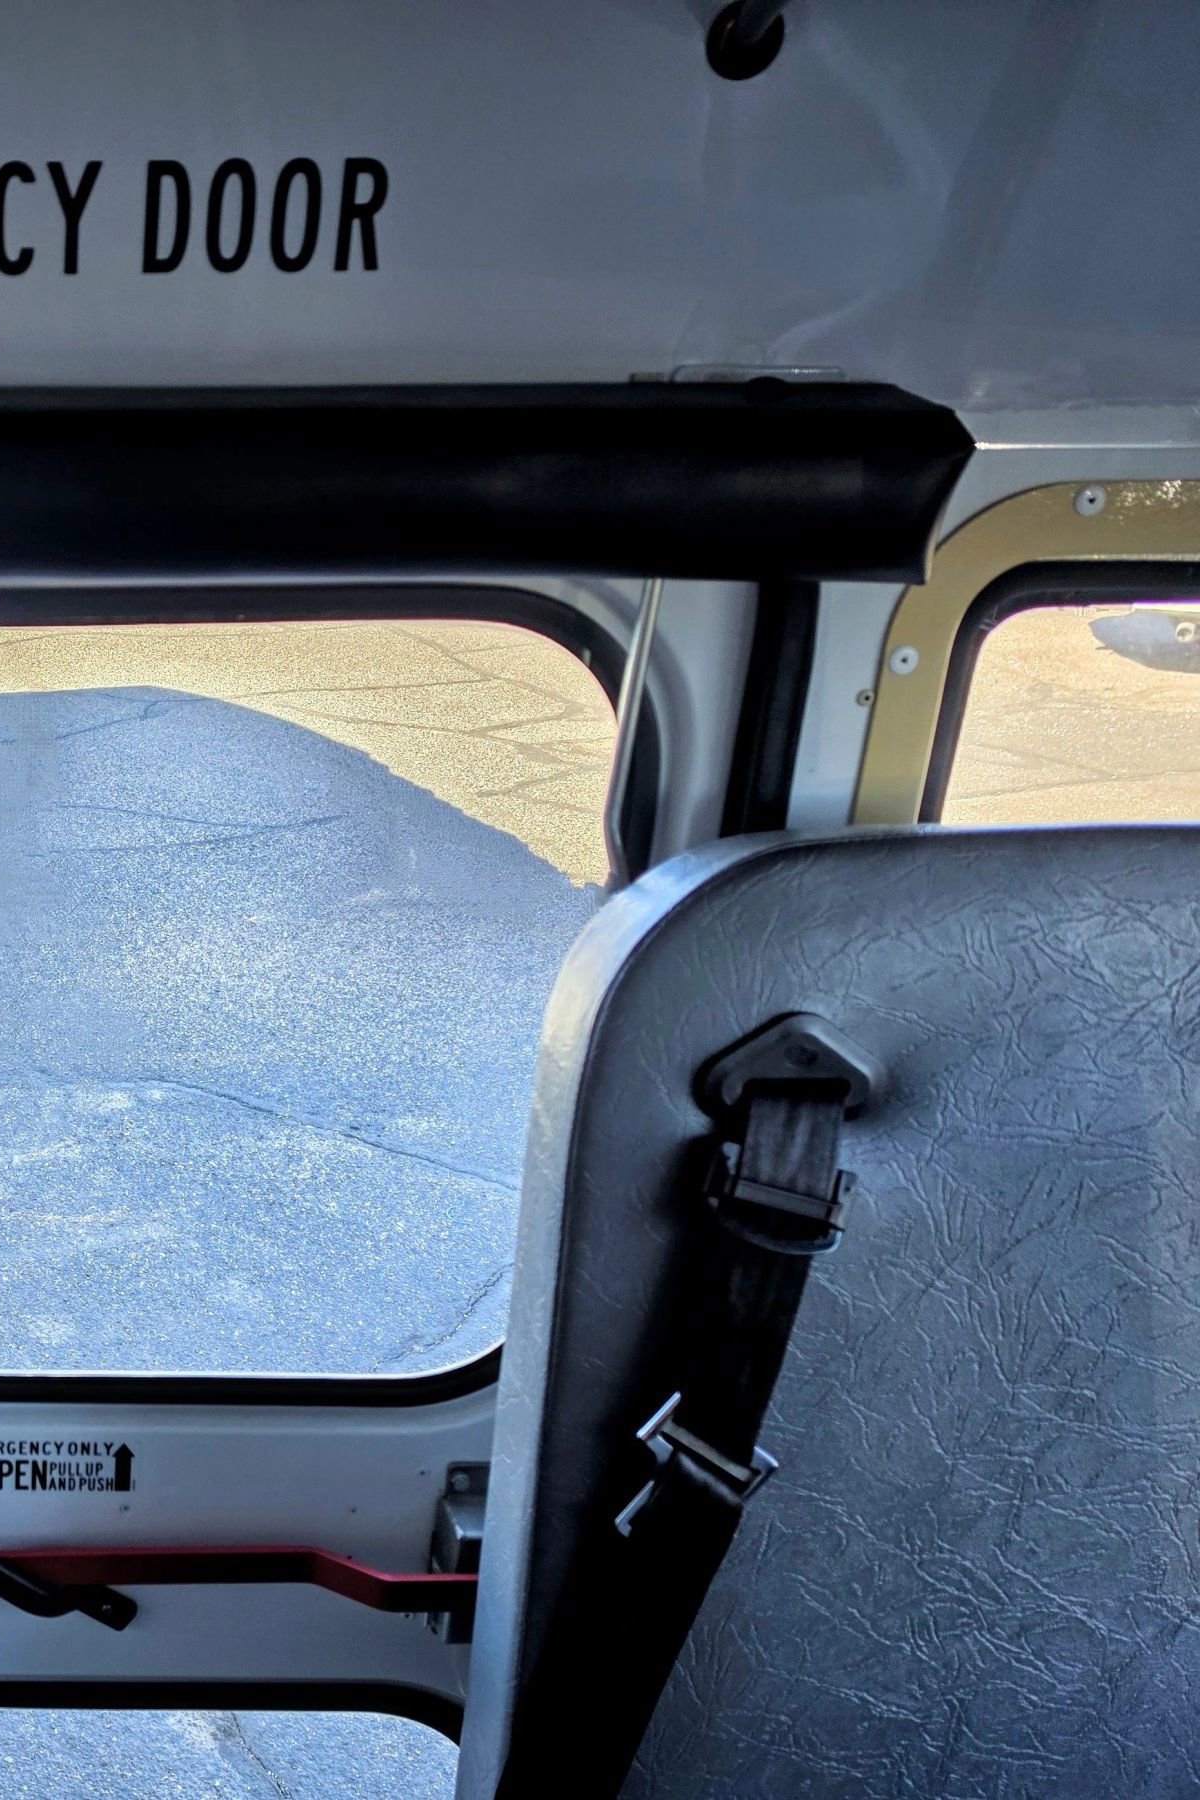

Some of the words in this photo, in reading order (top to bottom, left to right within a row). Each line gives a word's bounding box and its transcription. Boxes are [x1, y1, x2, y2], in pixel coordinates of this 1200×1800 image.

[140, 156, 391, 275] DOOR
[67, 1441, 114, 1456] ONLY
[49, 1461, 83, 1477] PULL
[85, 1462, 104, 1477] UP
[48, 1477, 76, 1492] AND
[78, 1477, 114, 1492] PUSH
